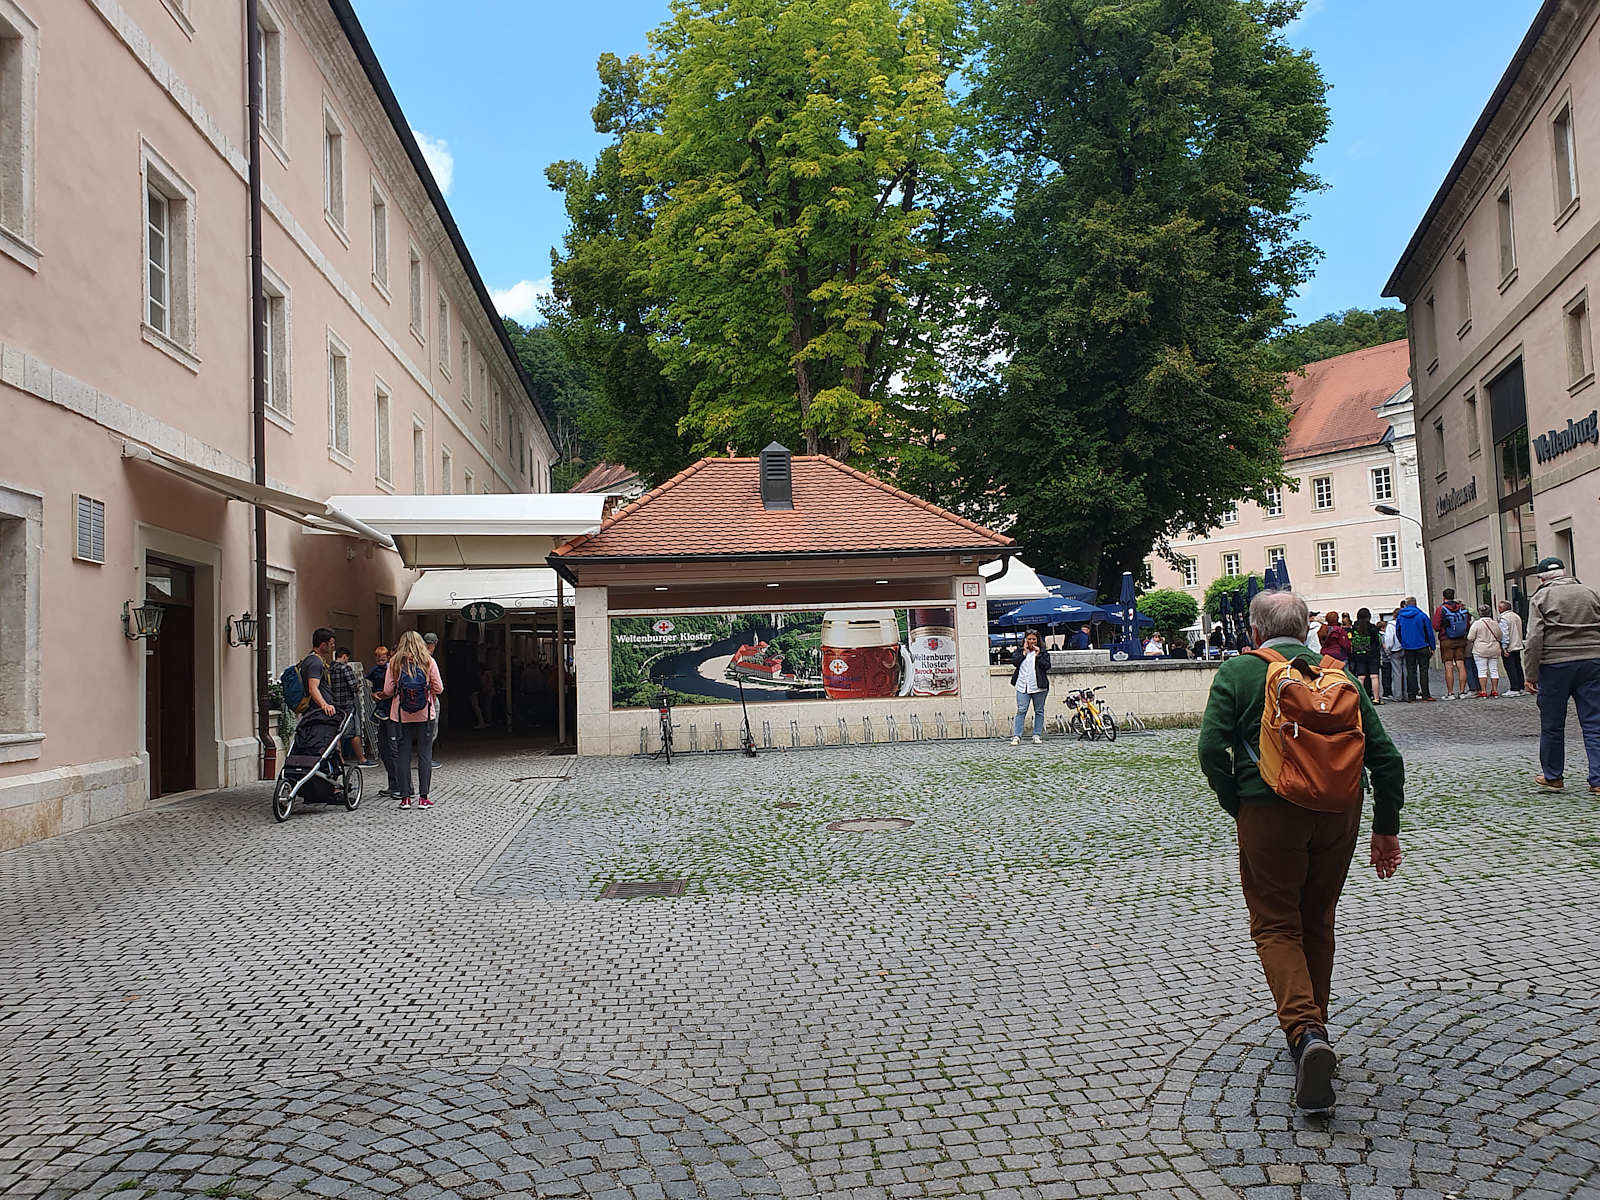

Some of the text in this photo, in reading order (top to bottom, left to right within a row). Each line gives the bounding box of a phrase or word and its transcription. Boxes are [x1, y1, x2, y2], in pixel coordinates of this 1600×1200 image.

[1532, 410, 1599, 465] Weltenburg
[615, 632, 713, 643] Weltenburger Kloster
[921, 661, 947, 669] Kloster
